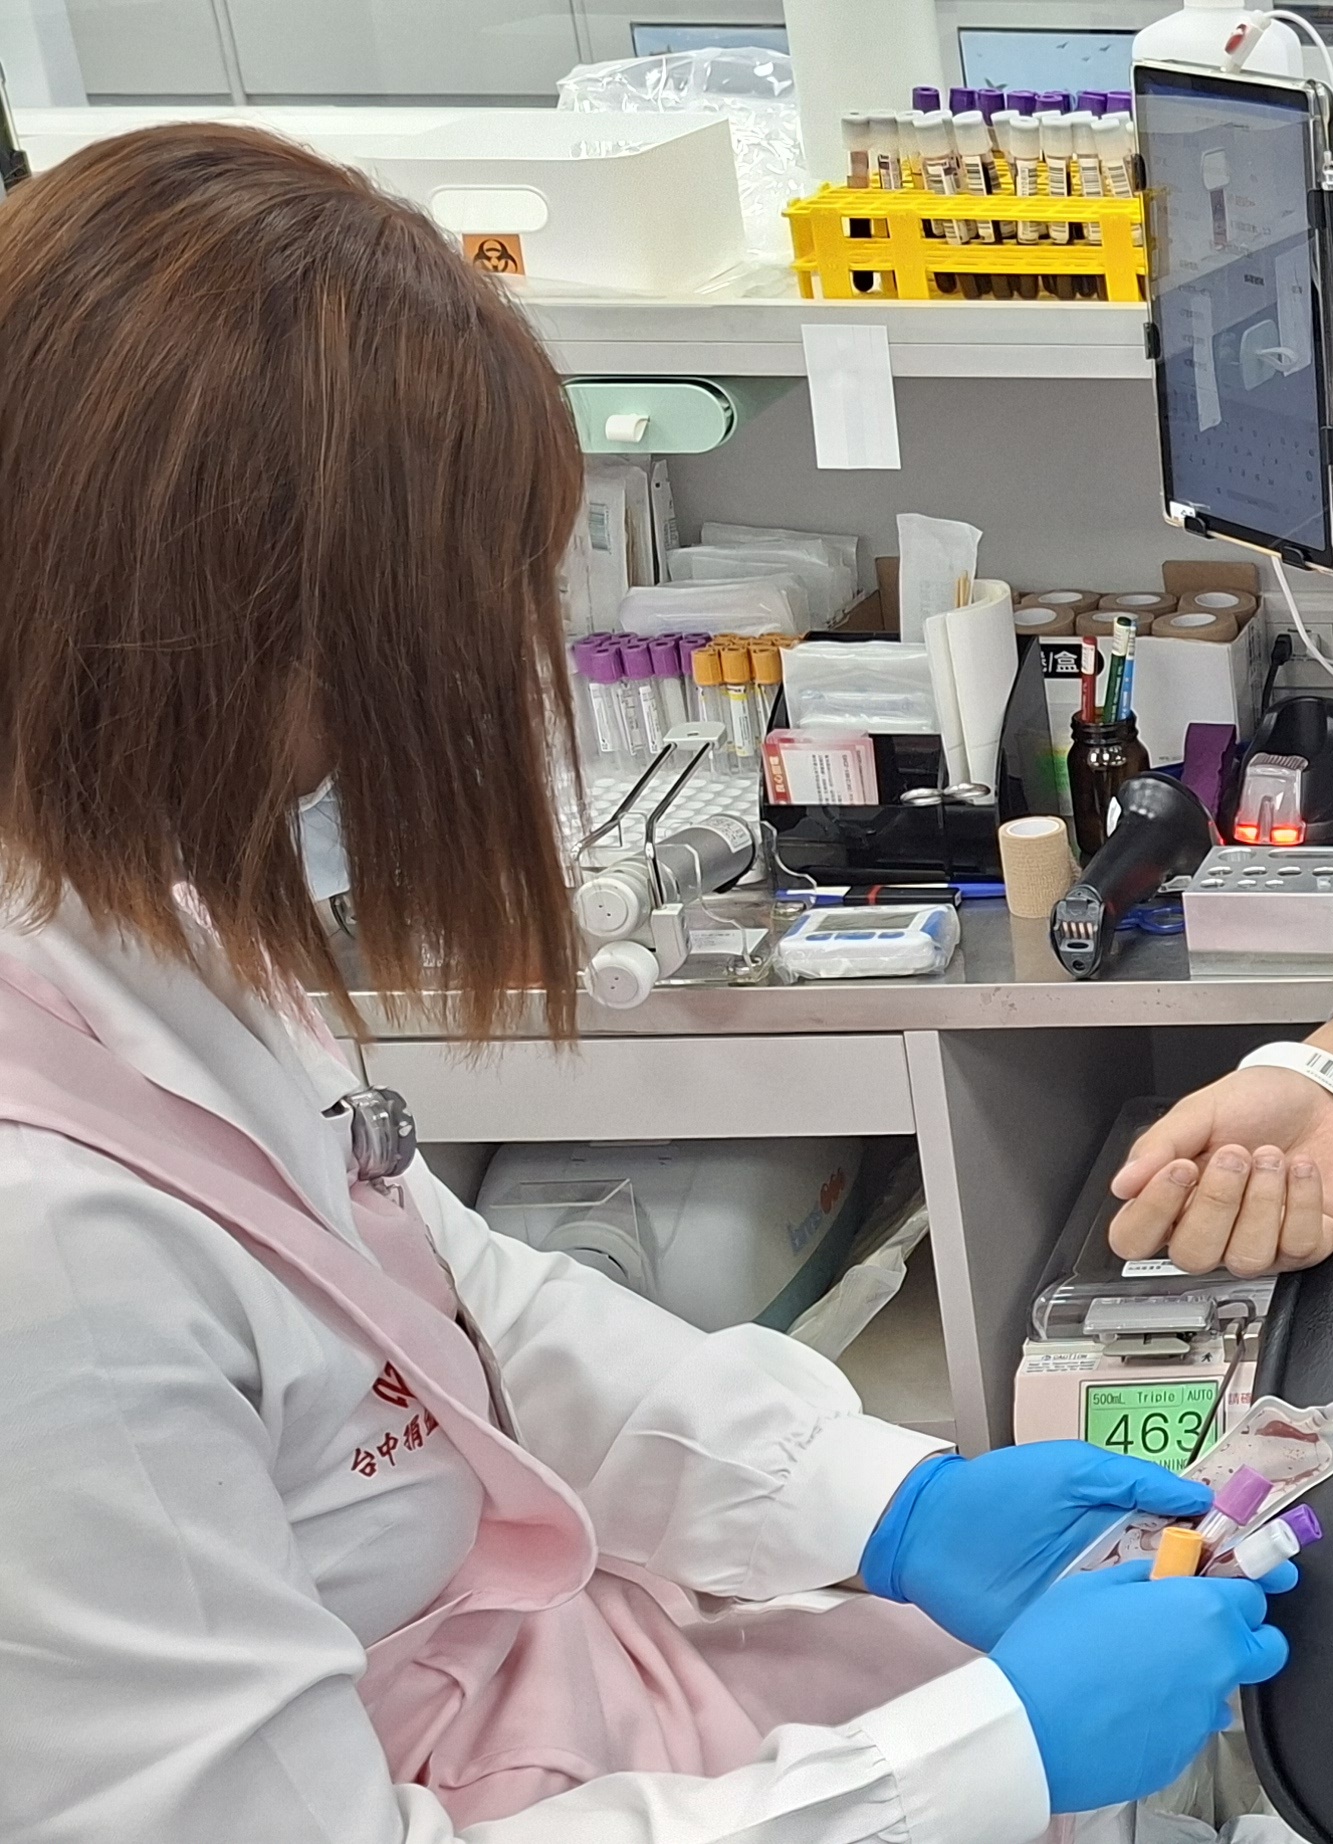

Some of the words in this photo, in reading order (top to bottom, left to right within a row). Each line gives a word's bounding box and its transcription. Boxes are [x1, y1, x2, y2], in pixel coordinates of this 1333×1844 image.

[1093, 1392, 1125, 1405] 500mL
[1137, 1391, 1175, 1404] Triple
[1187, 1389, 1213, 1401] AUTO
[1105, 1411, 1202, 1455] 463
